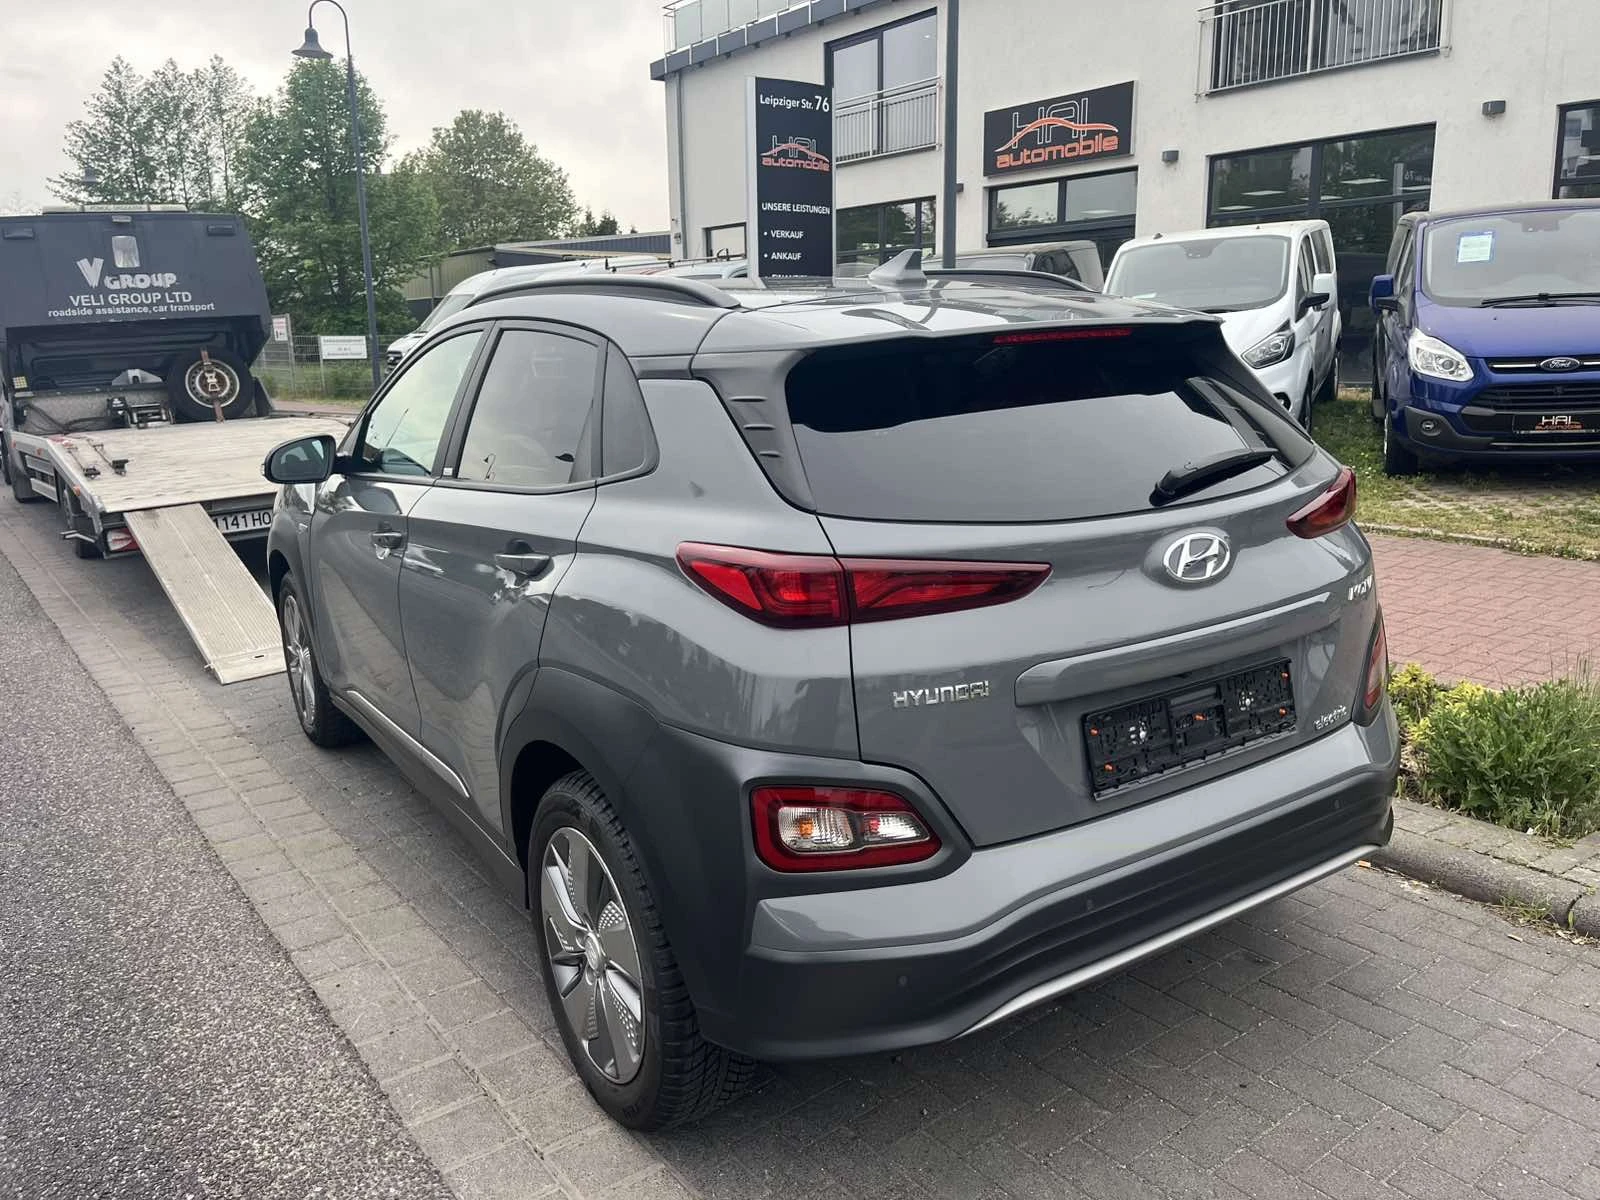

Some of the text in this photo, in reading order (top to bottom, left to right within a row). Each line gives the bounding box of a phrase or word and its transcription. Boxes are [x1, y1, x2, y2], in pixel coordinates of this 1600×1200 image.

[759, 93, 830, 113] Leipziger Str. 76
[996, 132, 1119, 169] automobile
[761, 156, 831, 172] automobile
[761, 202, 831, 215] UNSERE LEISTUNGEN
[770, 229, 804, 239] VERKAUF
[770, 252, 802, 260] ANKAUF
[104, 272, 177, 290] GROUP
[69, 291, 192, 307] VELI GROUP LTD
[48, 307, 93, 317] roadside
[152, 305, 168, 313] car
[170, 303, 215, 312] transport
[1549, 359, 1572, 369] Ford
[892, 680, 989, 708] HYUNDAI
